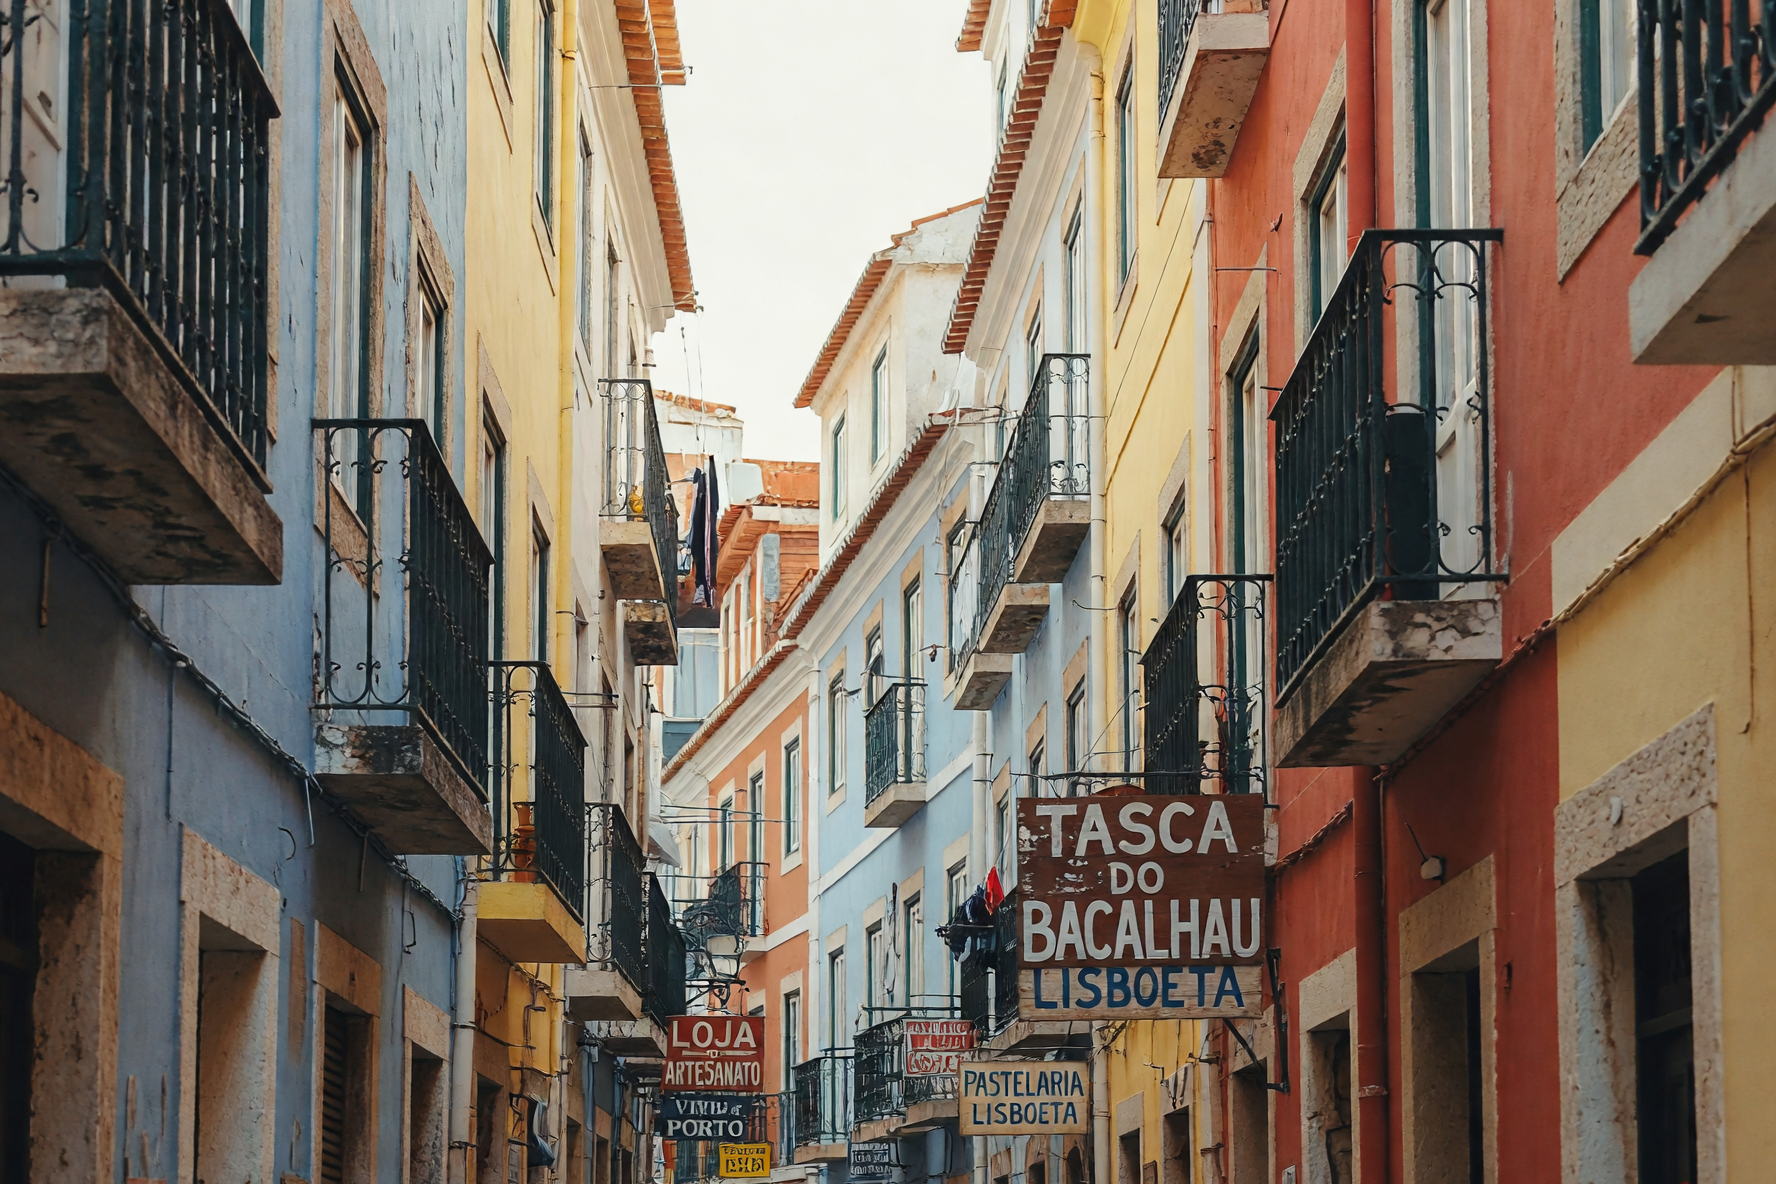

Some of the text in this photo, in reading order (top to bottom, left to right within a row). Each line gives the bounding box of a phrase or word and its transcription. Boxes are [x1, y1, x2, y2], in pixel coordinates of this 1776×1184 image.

[1036, 801, 1237, 857] TASCA
[1108, 861, 1165, 894] DO
[1022, 898, 1261, 961] BACALHAU
[1033, 966, 1245, 1009] LISBOETA
[672, 1021, 756, 1048] LOJA
[665, 1061, 760, 1086] ARTESANATO
[965, 1070, 1084, 1097] PASTELARIA
[972, 1102, 1078, 1125] LISBOETA
[667, 1119, 744, 1137] PORTO
